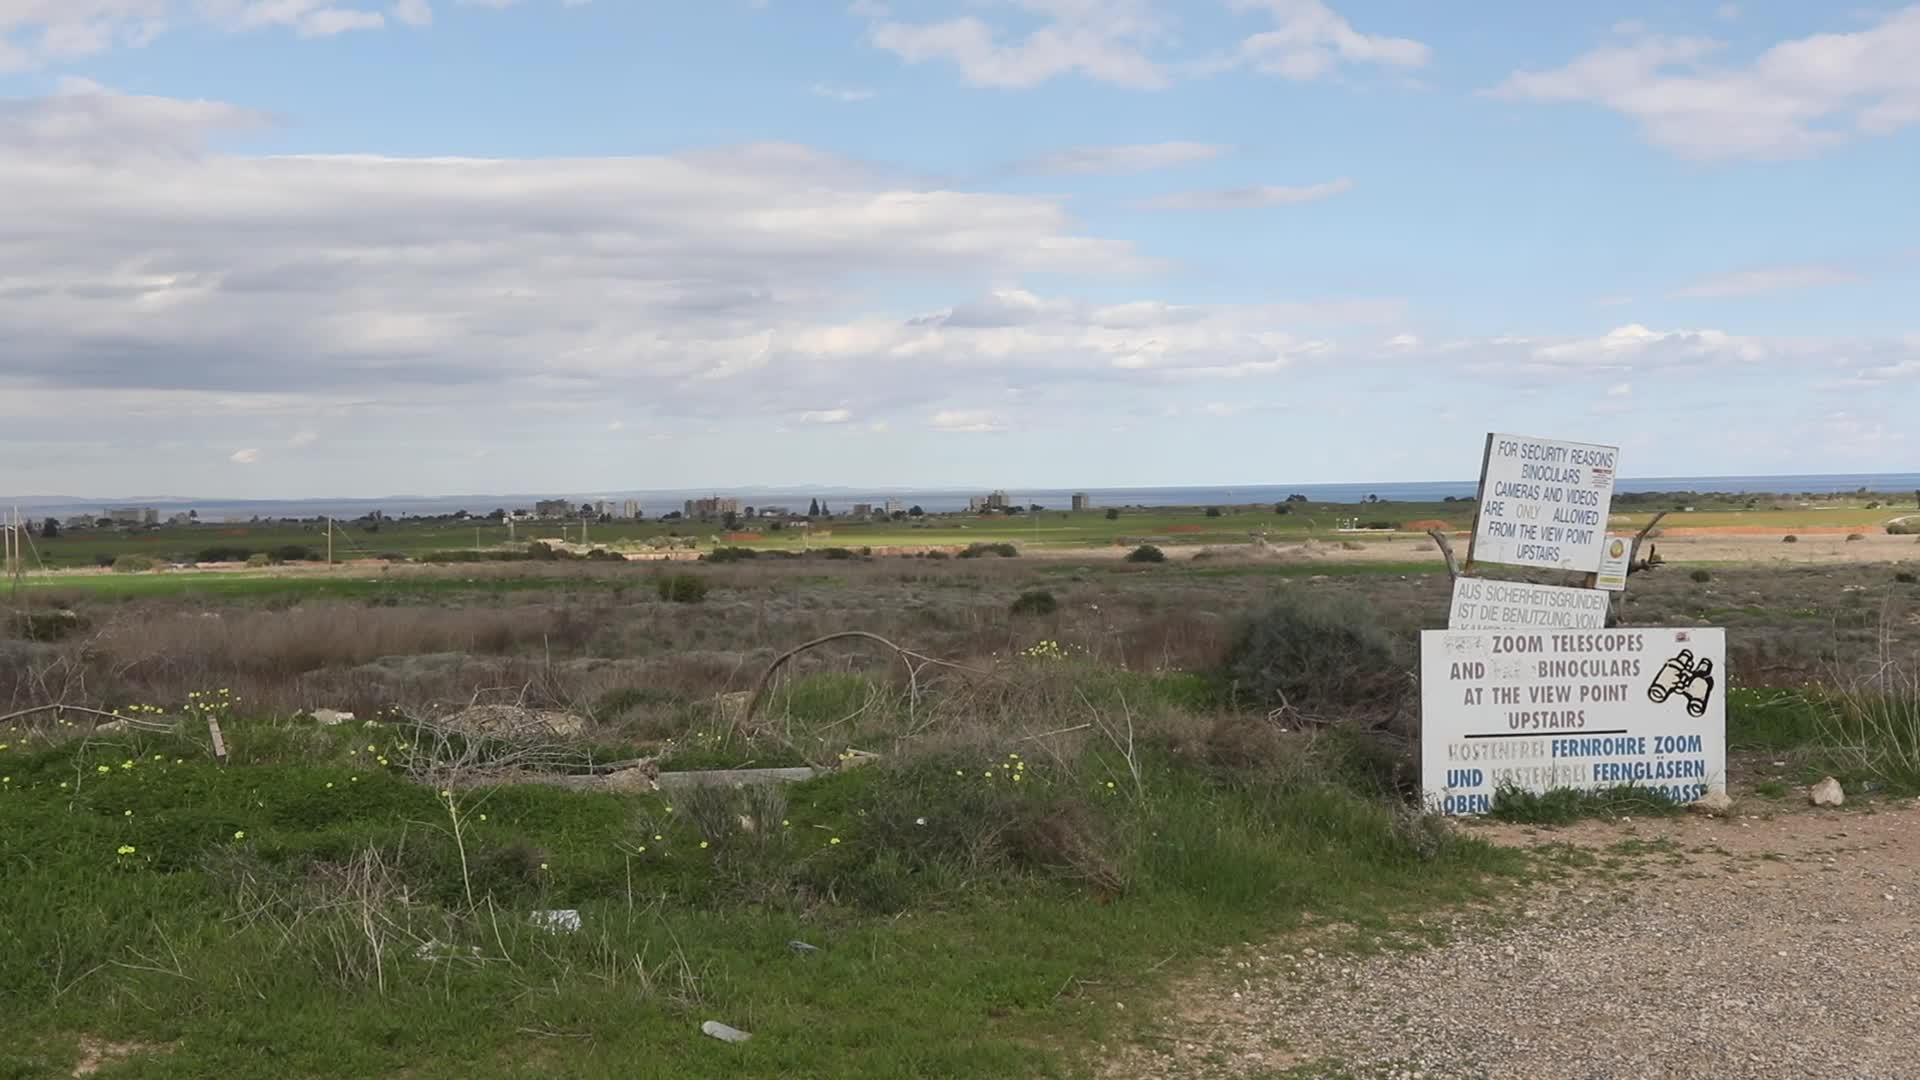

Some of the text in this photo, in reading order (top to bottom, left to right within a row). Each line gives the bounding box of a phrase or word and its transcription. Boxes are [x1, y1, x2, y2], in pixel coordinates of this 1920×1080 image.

[1498, 441, 1613, 468] FOR SECURITY REASONS
[1521, 464, 1580, 485] BINOCULARS
[1495, 481, 1599, 506] CAMERAS AND VIDEOS
[1484, 501, 1599, 525] ARE ONLY ALLOWED
[1488, 521, 1594, 544] FROM THE VIEW POINT
[1516, 544, 1560, 561] UPSTAIRS
[1457, 584, 1482, 600] AUS
[1457, 603, 1476, 618] IST
[1480, 605, 1499, 621] DIE
[1502, 607, 1570, 628] BENUTZUNG
[1492, 635, 1544, 653] ZOOM
[1551, 634, 1644, 653] TELESCOPES
[1450, 662, 1485, 680] AND
[1538, 659, 1641, 678] BINOCULARS
[1464, 684, 1628, 705] AT THE VIEW POINT
[1508, 710, 1585, 730] UPSTAIRS
[1552, 737, 1645, 758] FERNROHRE
[1654, 735, 1702, 754] ZOOM
[1447, 768, 1483, 788] UND
[1593, 756, 1705, 781] FERNGLÄSERN
[1443, 794, 1489, 814] OBEN
